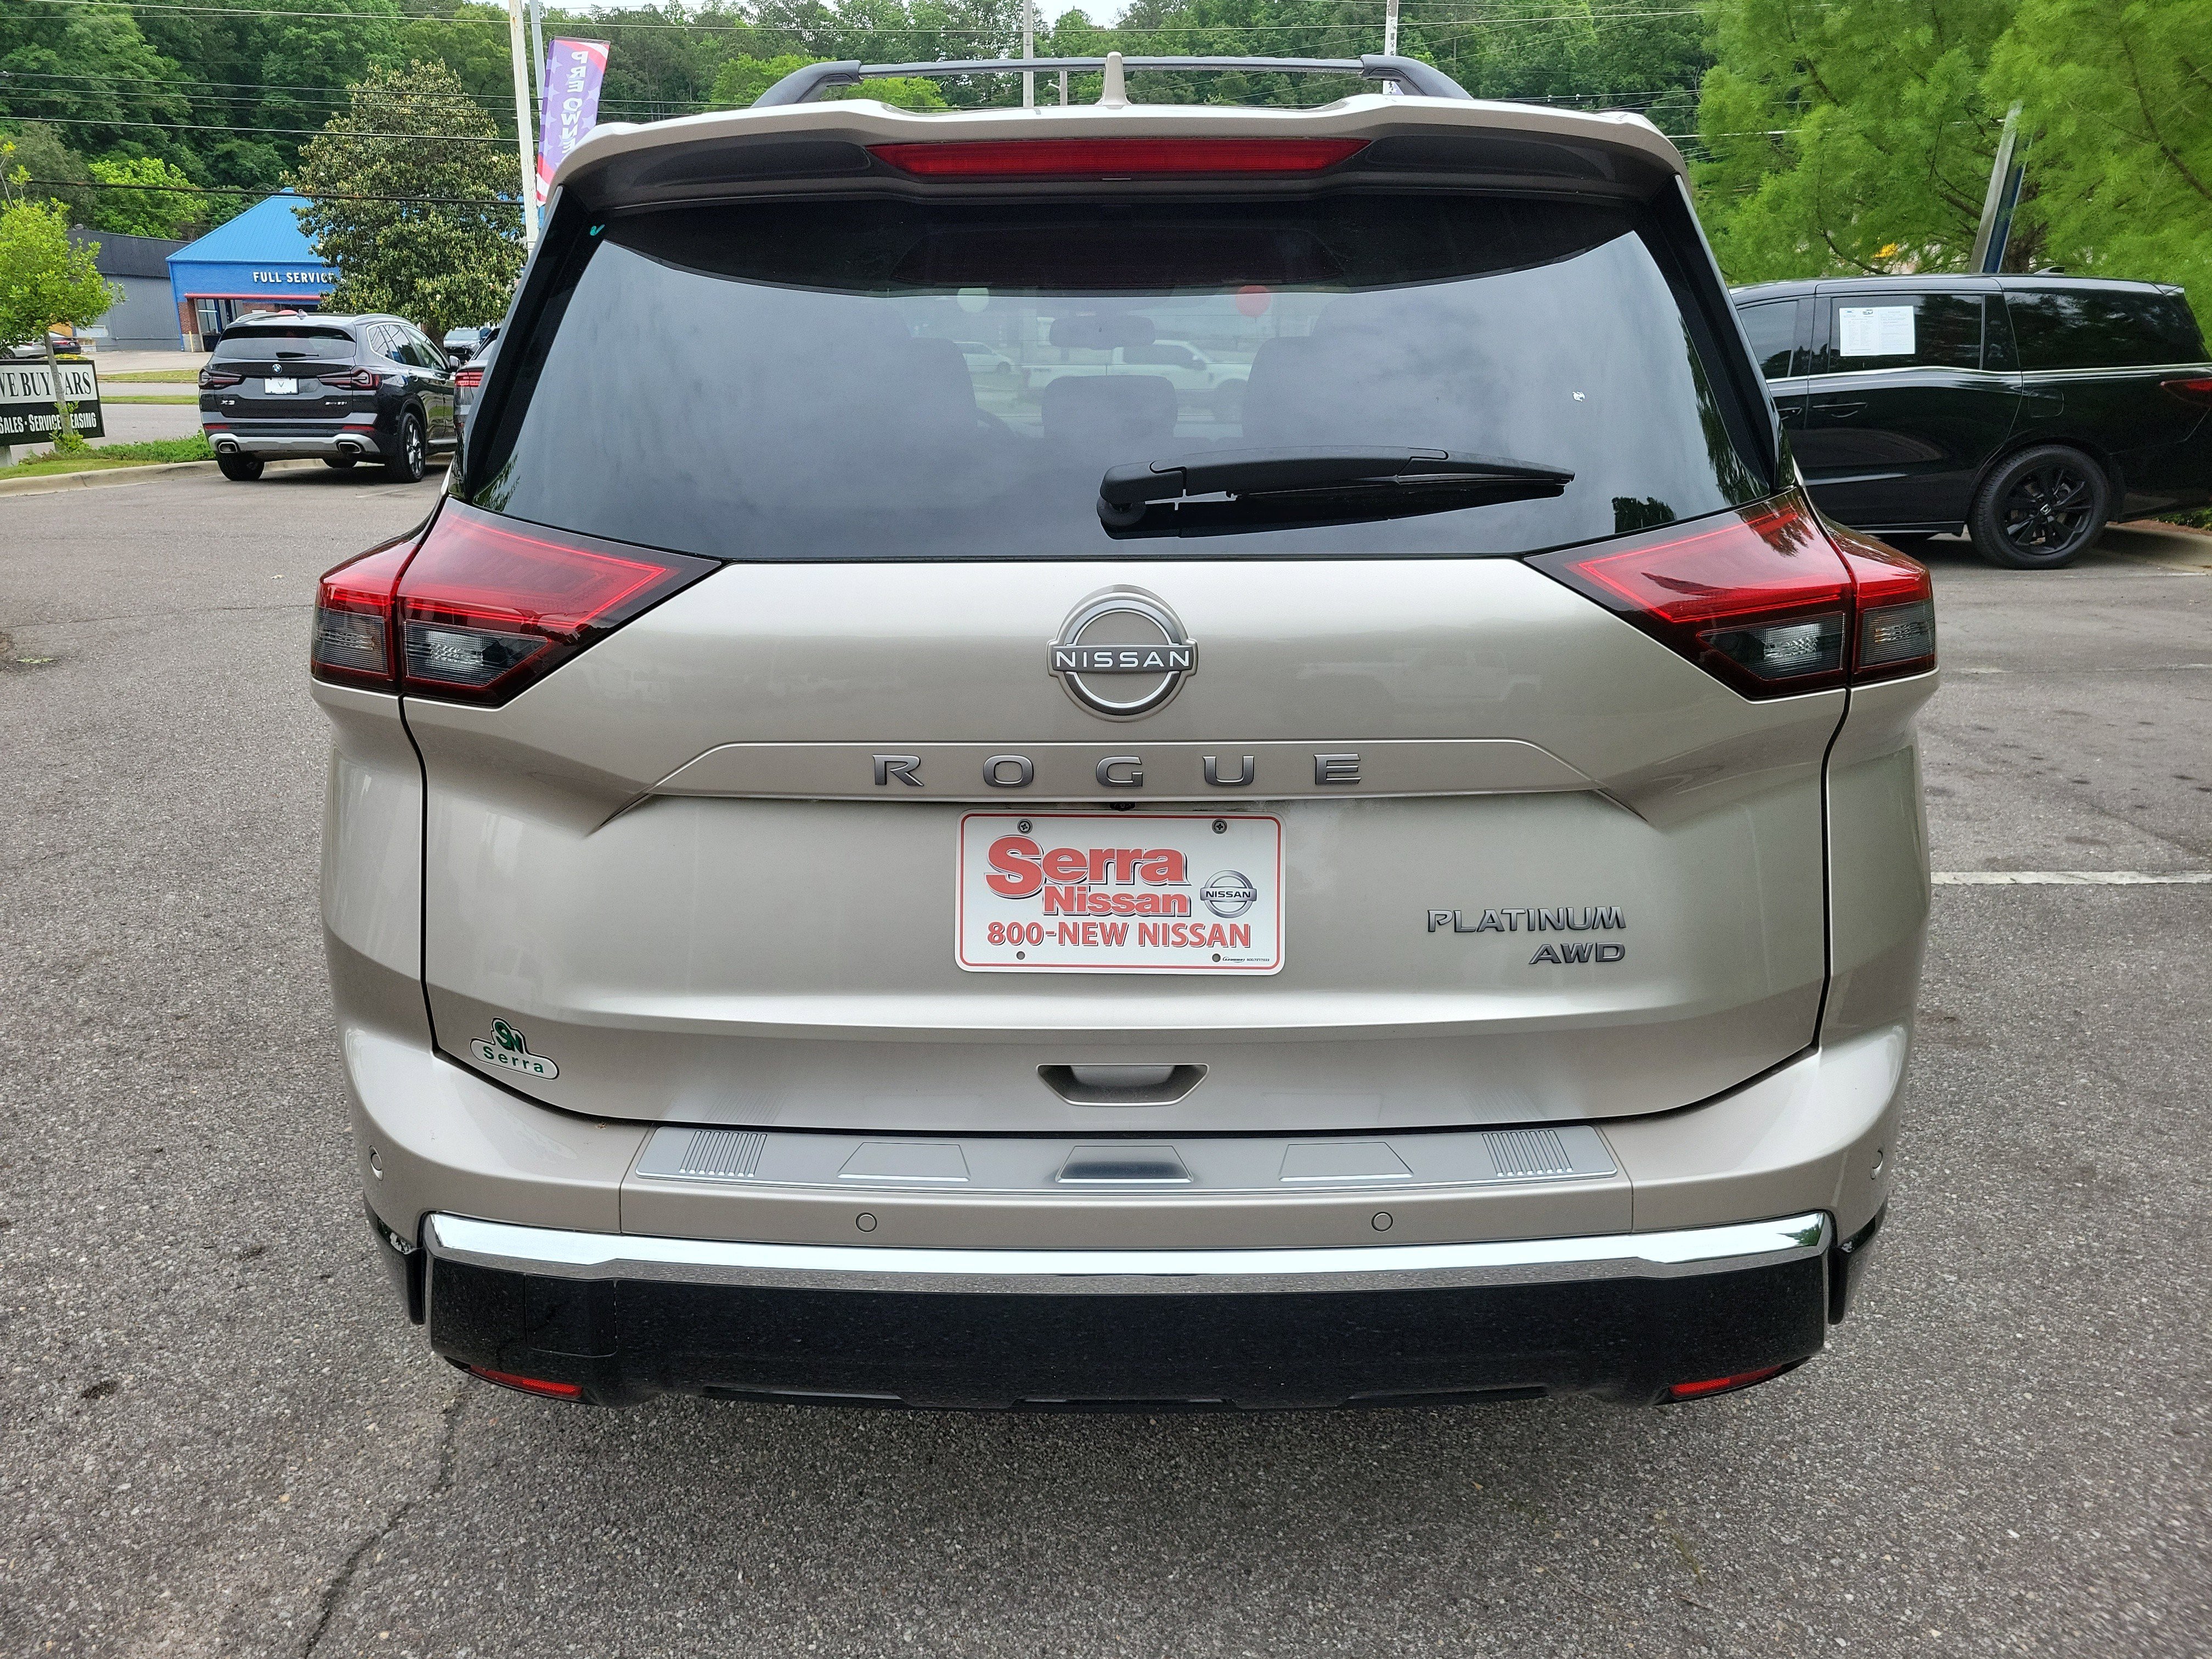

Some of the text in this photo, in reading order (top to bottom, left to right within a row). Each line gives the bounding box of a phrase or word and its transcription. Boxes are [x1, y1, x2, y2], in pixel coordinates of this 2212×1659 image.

[253, 272, 282, 283] FULL
[19, 372, 52, 396] BUY
[58, 371, 92, 395] ARS
[70, 412, 97, 429] EASING
[1056, 651, 1189, 668] NISSAN
[871, 753, 1362, 788] ROGUE
[984, 834, 1191, 899] Serra
[1043, 884, 1192, 917] Nissan
[1206, 890, 1251, 899] NISSAN
[1427, 906, 1627, 933] PLATINUM
[987, 921, 1251, 948] 800-NEW NISSAN
[1528, 941, 1626, 964] AWD
[483, 1046, 544, 1074] Serra
